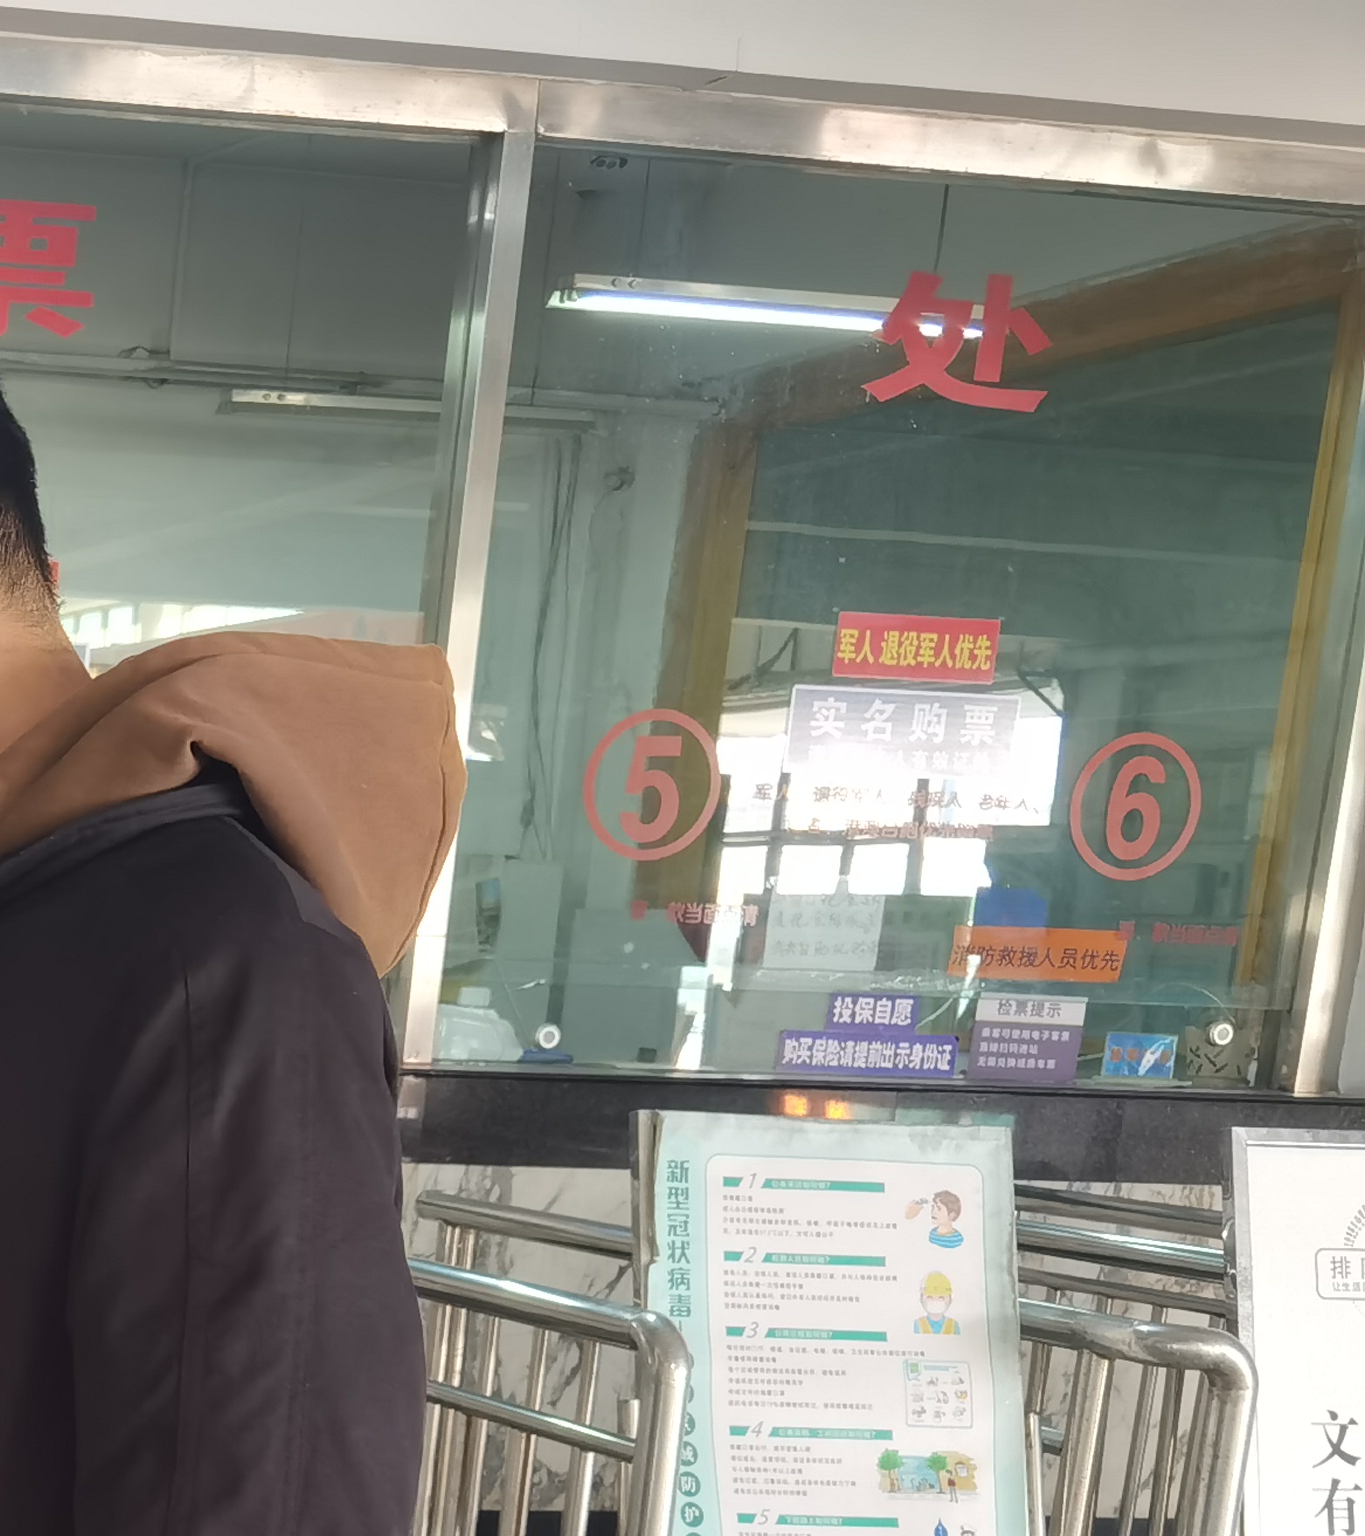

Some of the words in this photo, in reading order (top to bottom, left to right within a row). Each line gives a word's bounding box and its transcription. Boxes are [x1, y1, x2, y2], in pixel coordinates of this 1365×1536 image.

[860, 271, 1053, 414] 处
[837, 628, 875, 665] 军人
[879, 630, 992, 671] 退役军人优先
[809, 696, 999, 746] 实名购票
[950, 943, 1121, 972] 消防救援人员优先
[832, 995, 915, 1027] 投保自愿
[781, 1035, 953, 1072] 购买保险请提前出示身份证
[1310, 1409, 1363, 1469] 文
